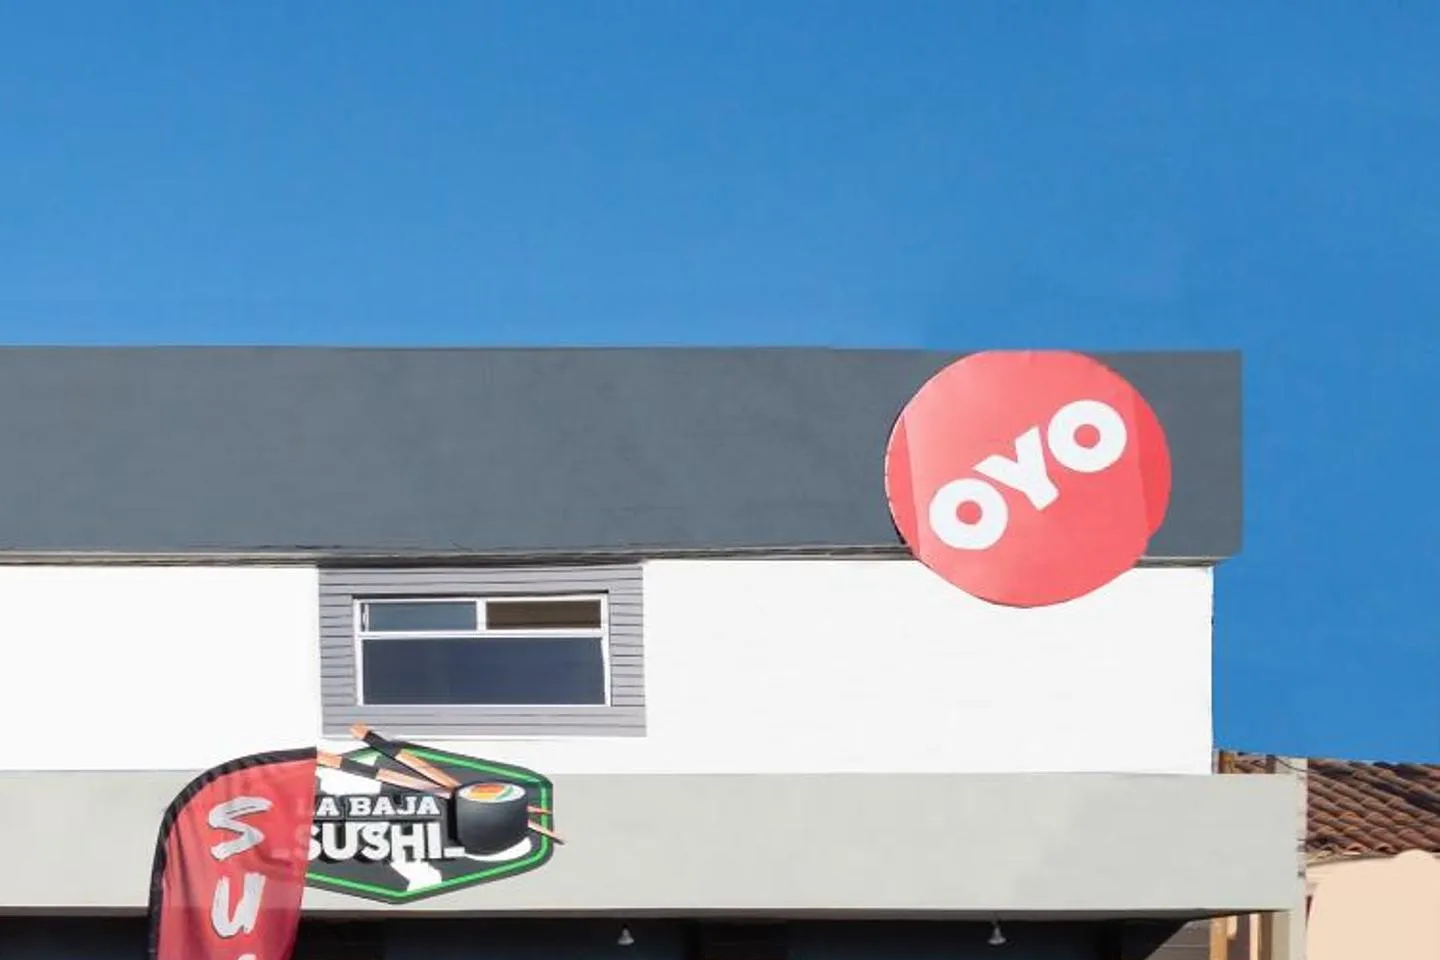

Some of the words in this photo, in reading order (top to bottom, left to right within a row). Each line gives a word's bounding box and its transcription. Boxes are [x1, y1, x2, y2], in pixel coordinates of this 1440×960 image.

[928, 399, 1127, 550] OYO
[302, 796, 340, 817] A
[349, 795, 441, 817] BAJA
